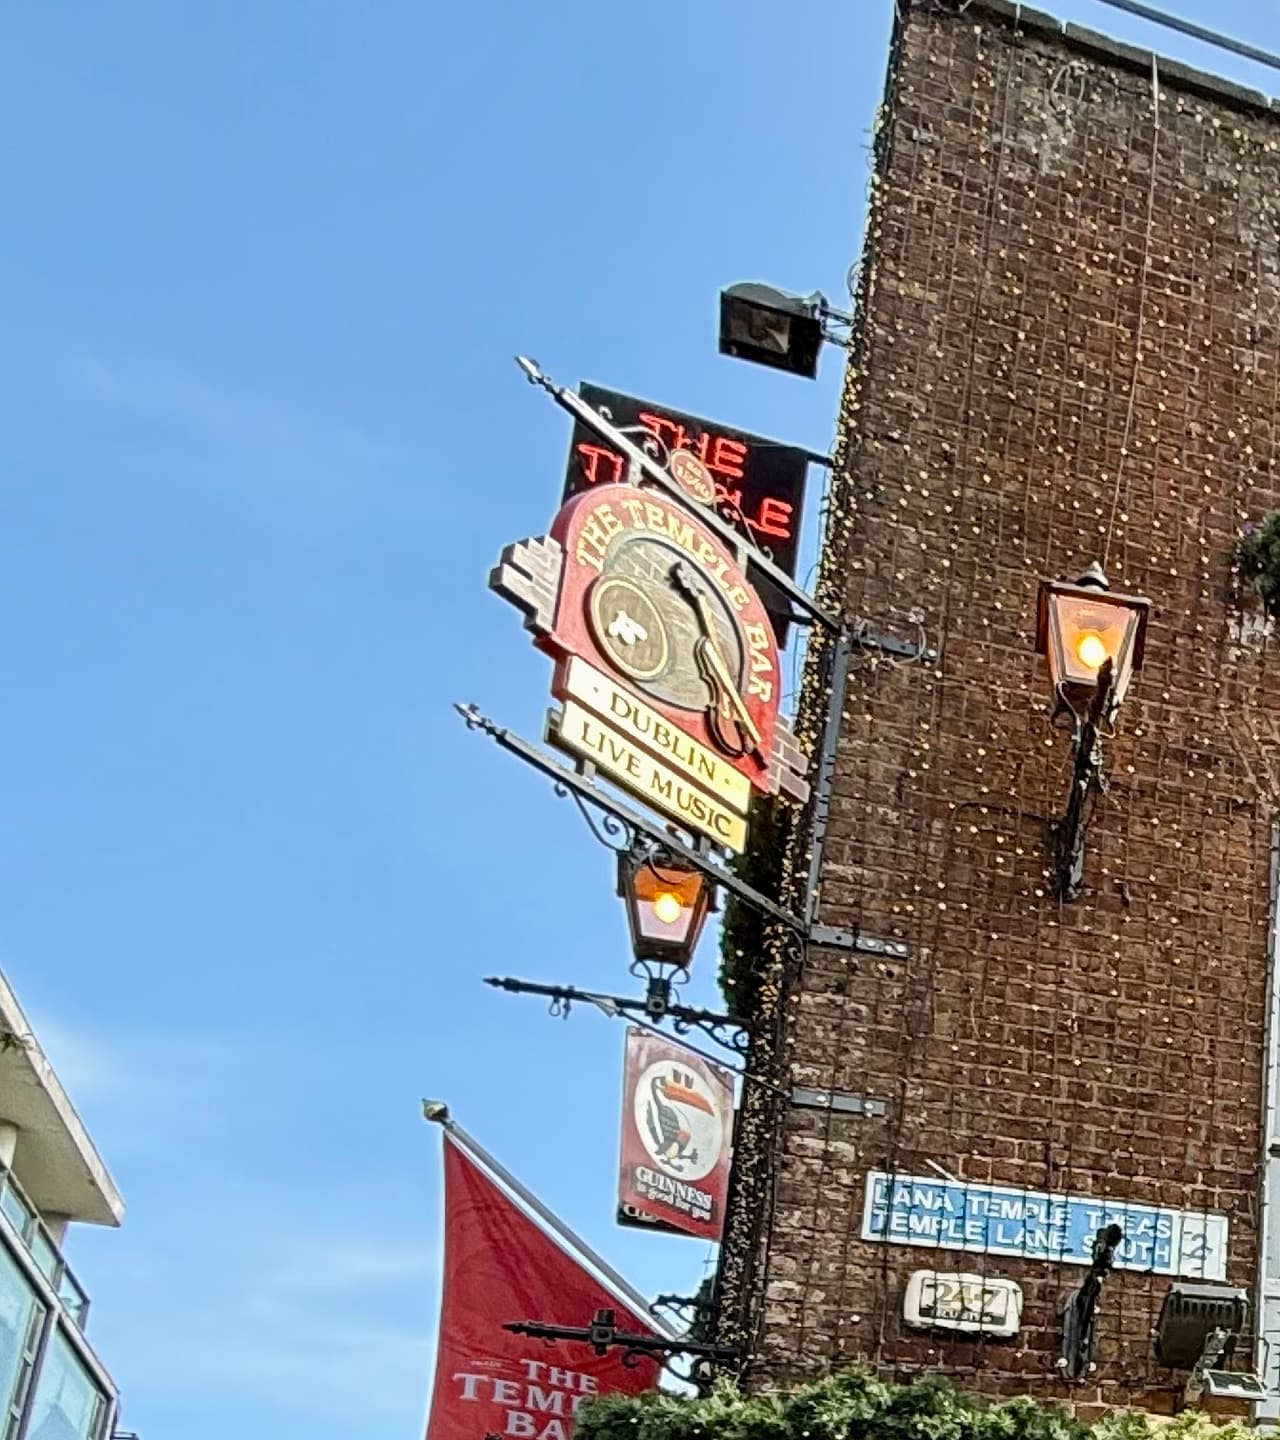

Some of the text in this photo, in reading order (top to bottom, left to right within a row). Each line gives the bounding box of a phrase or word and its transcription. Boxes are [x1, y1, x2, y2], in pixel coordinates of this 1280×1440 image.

[575, 498, 773, 704] THE TEMPLE BAR
[609, 692, 716, 783] DUBLIN
[580, 720, 734, 838] LIVE MUSIC
[636, 1165, 713, 1211] GUINNESS
[874, 1178, 1171, 1240] LANA TEMPLE THEAS
[873, 1208, 1171, 1264] TEMPLE LANE SUTH
[520, 1358, 600, 1395] THE
